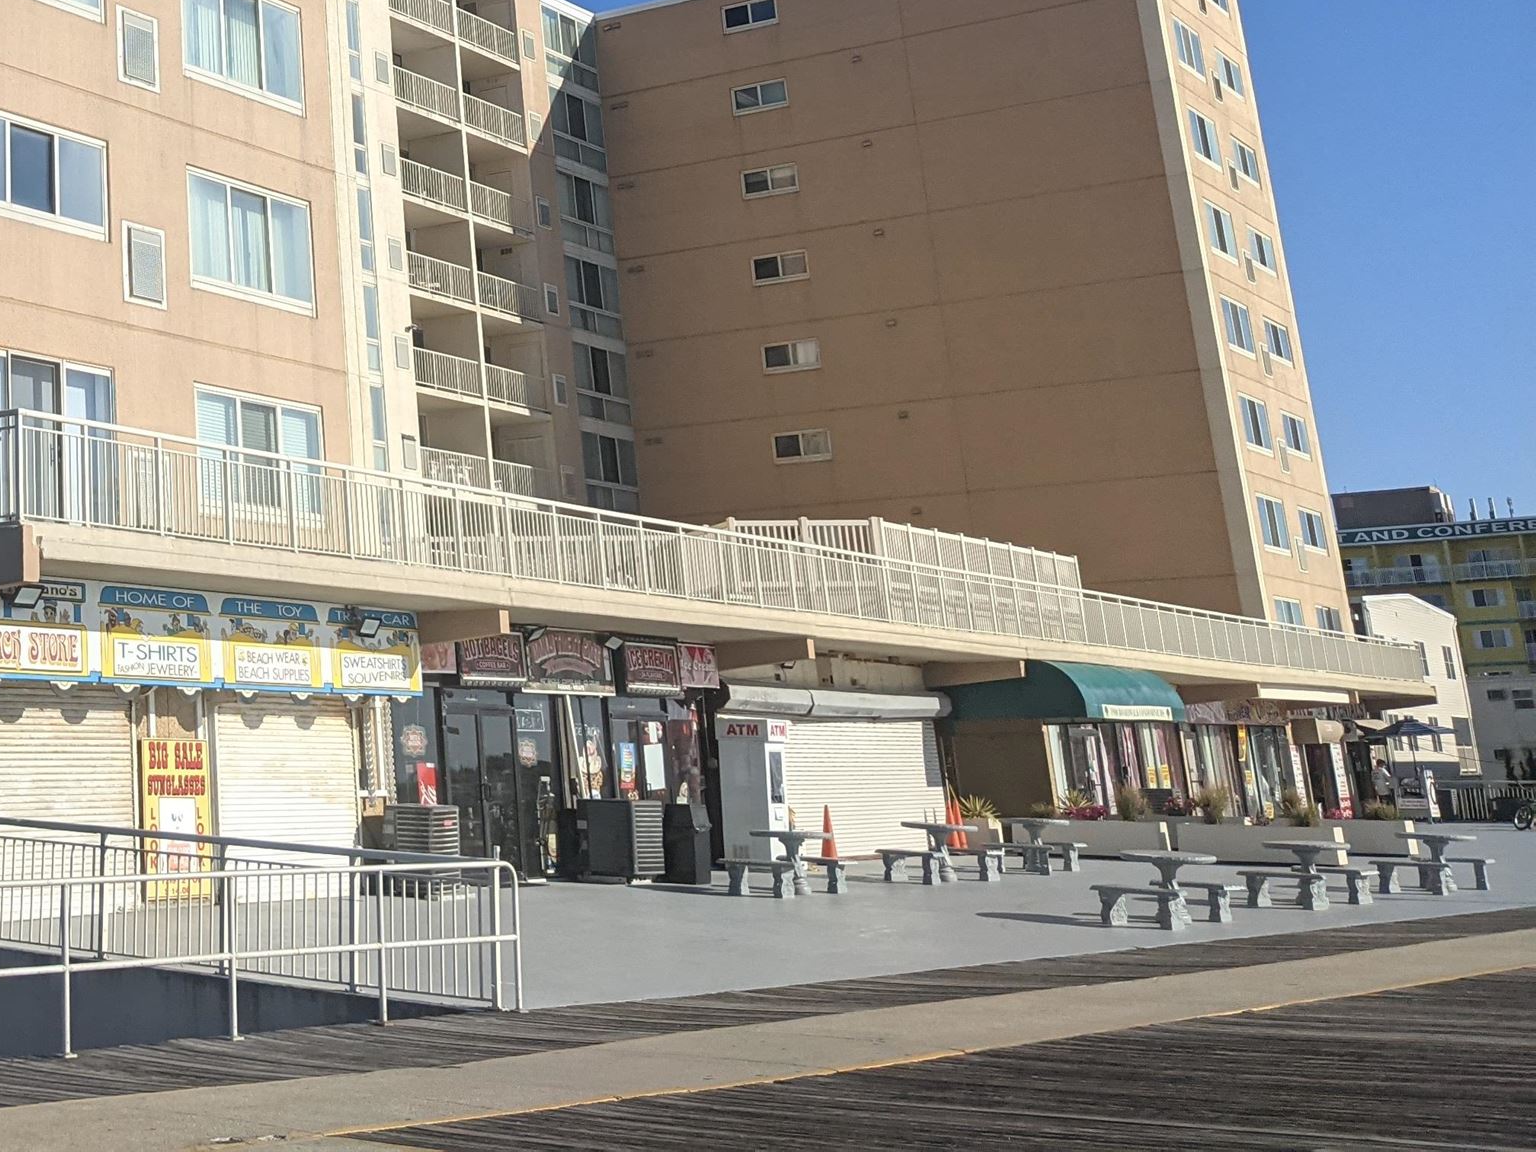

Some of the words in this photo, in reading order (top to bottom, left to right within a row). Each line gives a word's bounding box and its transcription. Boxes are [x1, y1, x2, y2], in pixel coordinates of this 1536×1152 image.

[1353, 528, 1409, 543] AND
[115, 590, 167, 605] HOME
[172, 595, 195, 608] OF
[235, 600, 263, 615] THE
[276, 604, 303, 617] TOY
[381, 613, 410, 626] CAR
[29, 632, 79, 666] STORE
[463, 637, 484, 660] HOT
[483, 635, 519, 663] BAGELS
[246, 650, 273, 664] BEACH
[274, 652, 300, 665] WEAR
[343, 656, 407, 672] SWEATSHIRTS
[627, 648, 644, 671] ICE
[643, 649, 674, 673] CREAM
[117, 661, 145, 674] FASHION
[238, 666, 270, 680] BEACH
[272, 668, 310, 682] SUPPLIES
[347, 671, 407, 685] SOUVENIRS
[726, 724, 759, 736] ATM
[769, 724, 786, 736] ATM
[148, 741, 169, 769] BIG
[174, 742, 203, 770] SALE
[147, 774, 206, 796] SUNGLASSES
